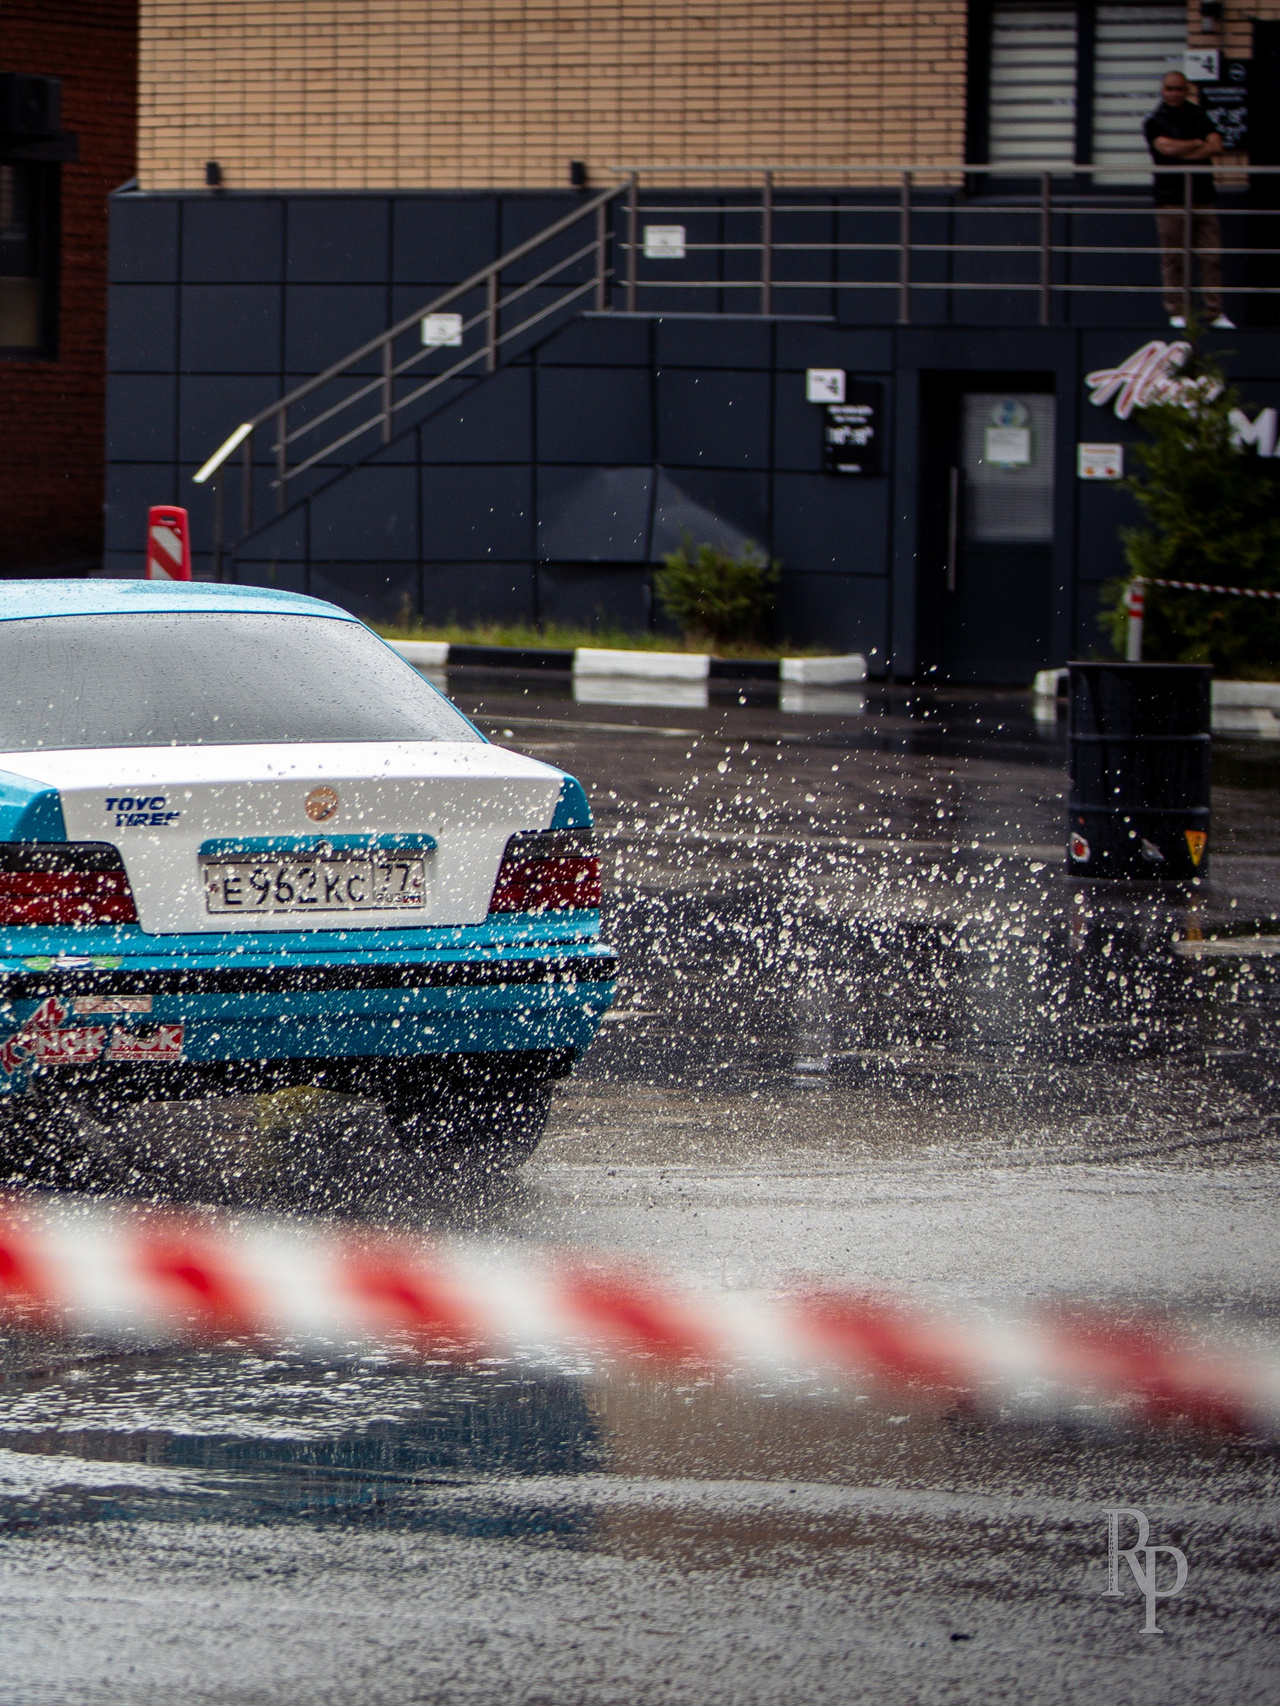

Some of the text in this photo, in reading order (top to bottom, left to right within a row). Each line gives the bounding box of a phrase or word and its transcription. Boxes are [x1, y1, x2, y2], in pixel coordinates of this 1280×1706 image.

[105, 796, 167, 811] TOYO
[379, 863, 410, 892] 77
[37, 1029, 107, 1056] NGK
